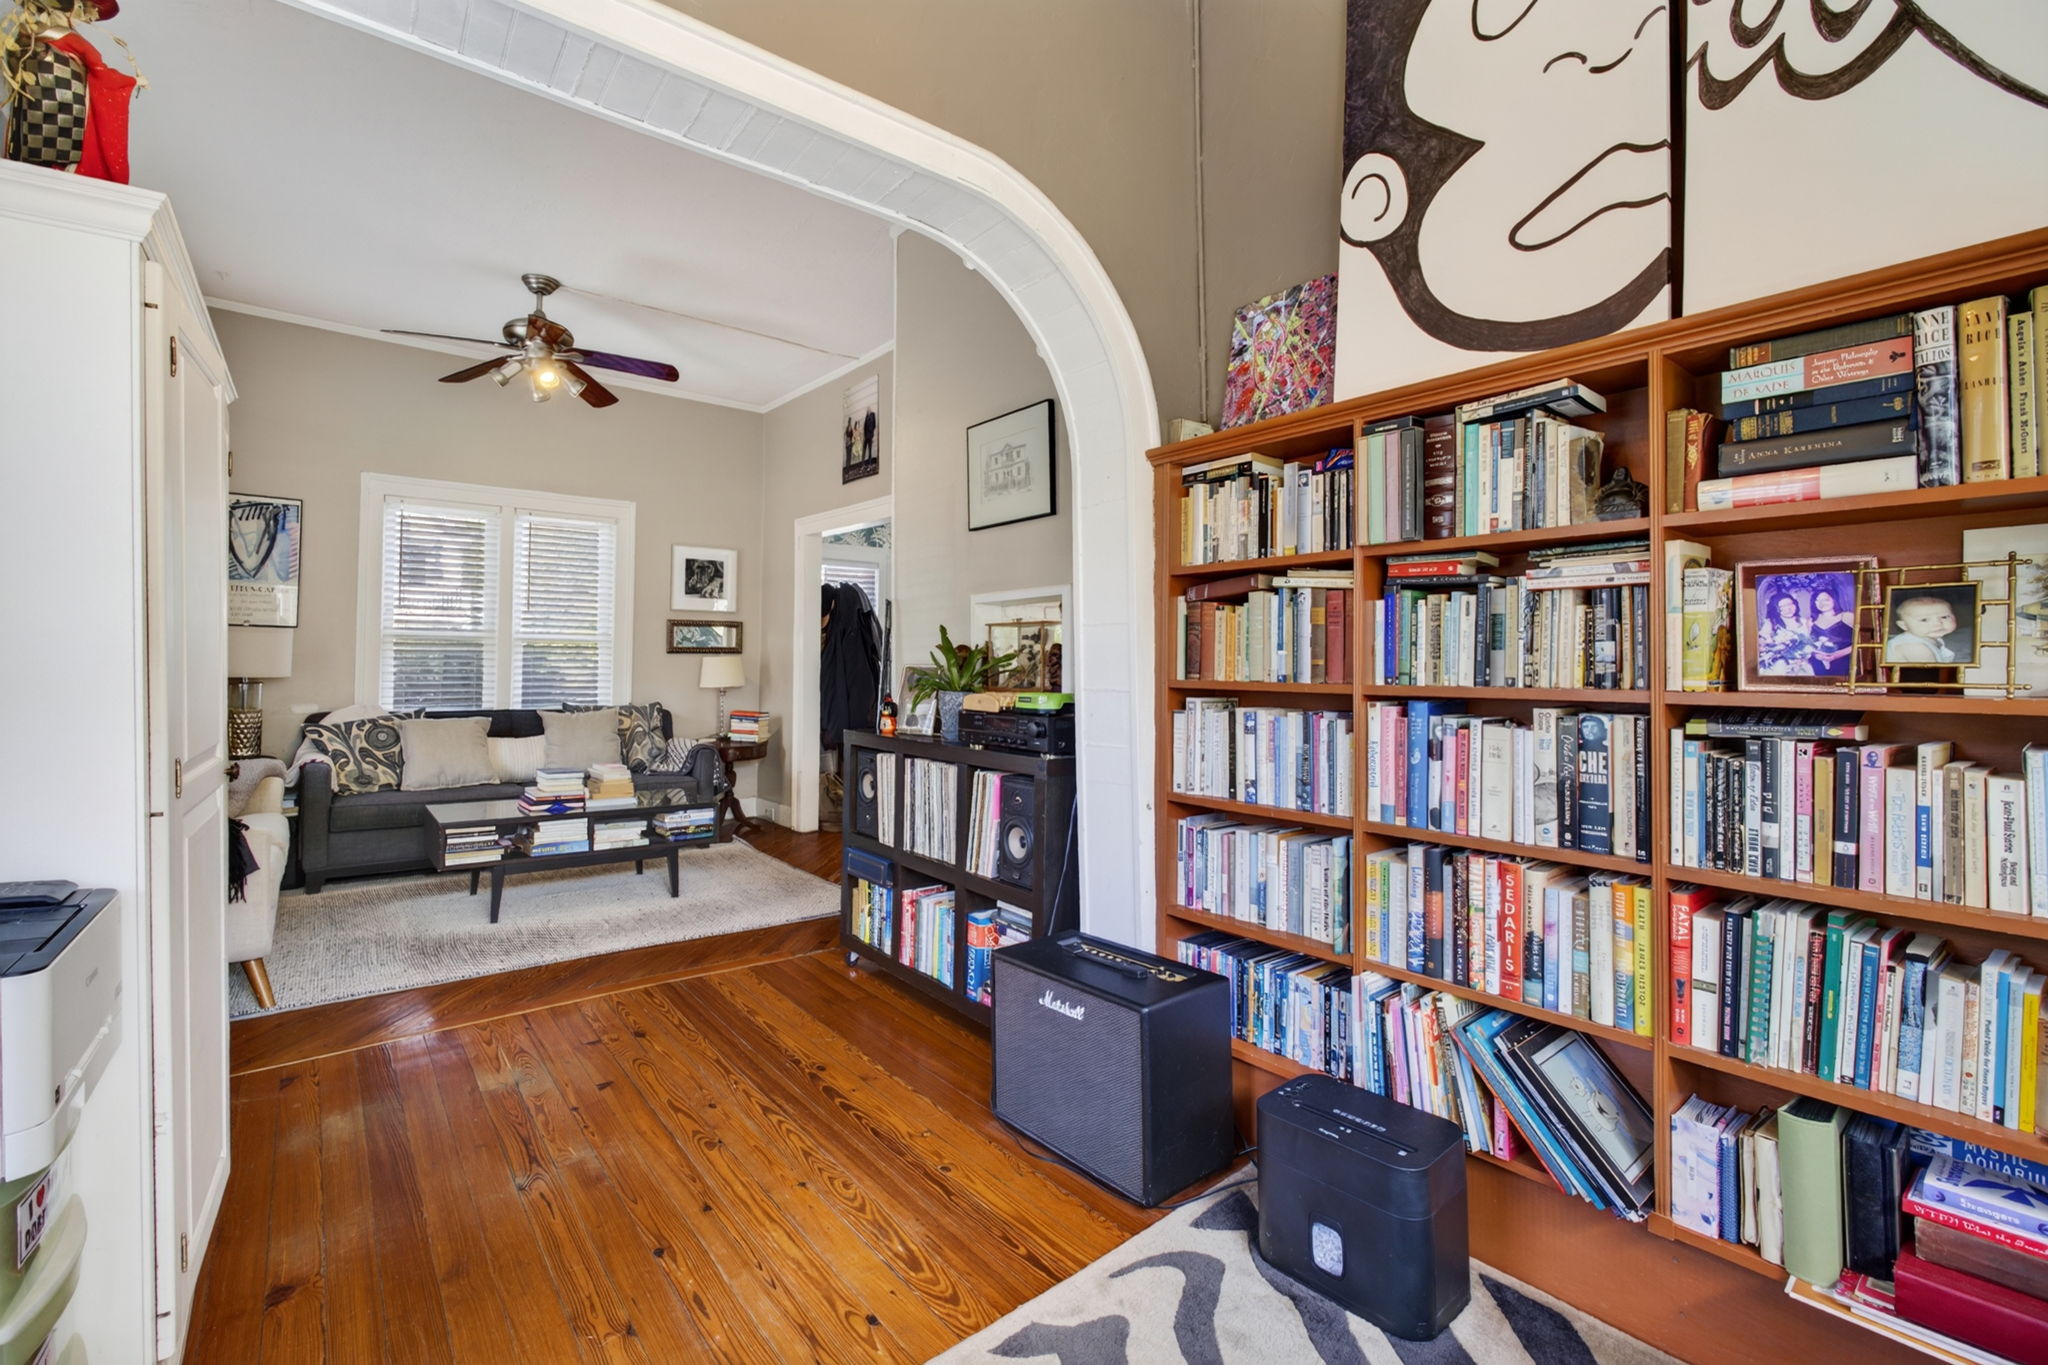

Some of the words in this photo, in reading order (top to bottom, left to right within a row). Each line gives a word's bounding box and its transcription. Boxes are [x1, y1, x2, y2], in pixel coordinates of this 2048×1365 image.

[1915, 329, 1949, 348] RICE
[1728, 360, 1796, 384] MARQUIS
[2018, 360, 2027, 386] Ashes
[1733, 386, 1750, 398] DE
[1754, 380, 1790, 395] SADE
[2018, 391, 2028, 417] Frank
[2019, 419, 2029, 455] McCourt
[1748, 450, 1778, 461] ANNA
[1784, 440, 1843, 455] KARENINA
[1579, 752, 1607, 774] CHE
[1504, 874, 1516, 972] SEDARIS
[1039, 989, 1086, 1021] Marshall
[1960, 1198, 2020, 1224] Strangers
